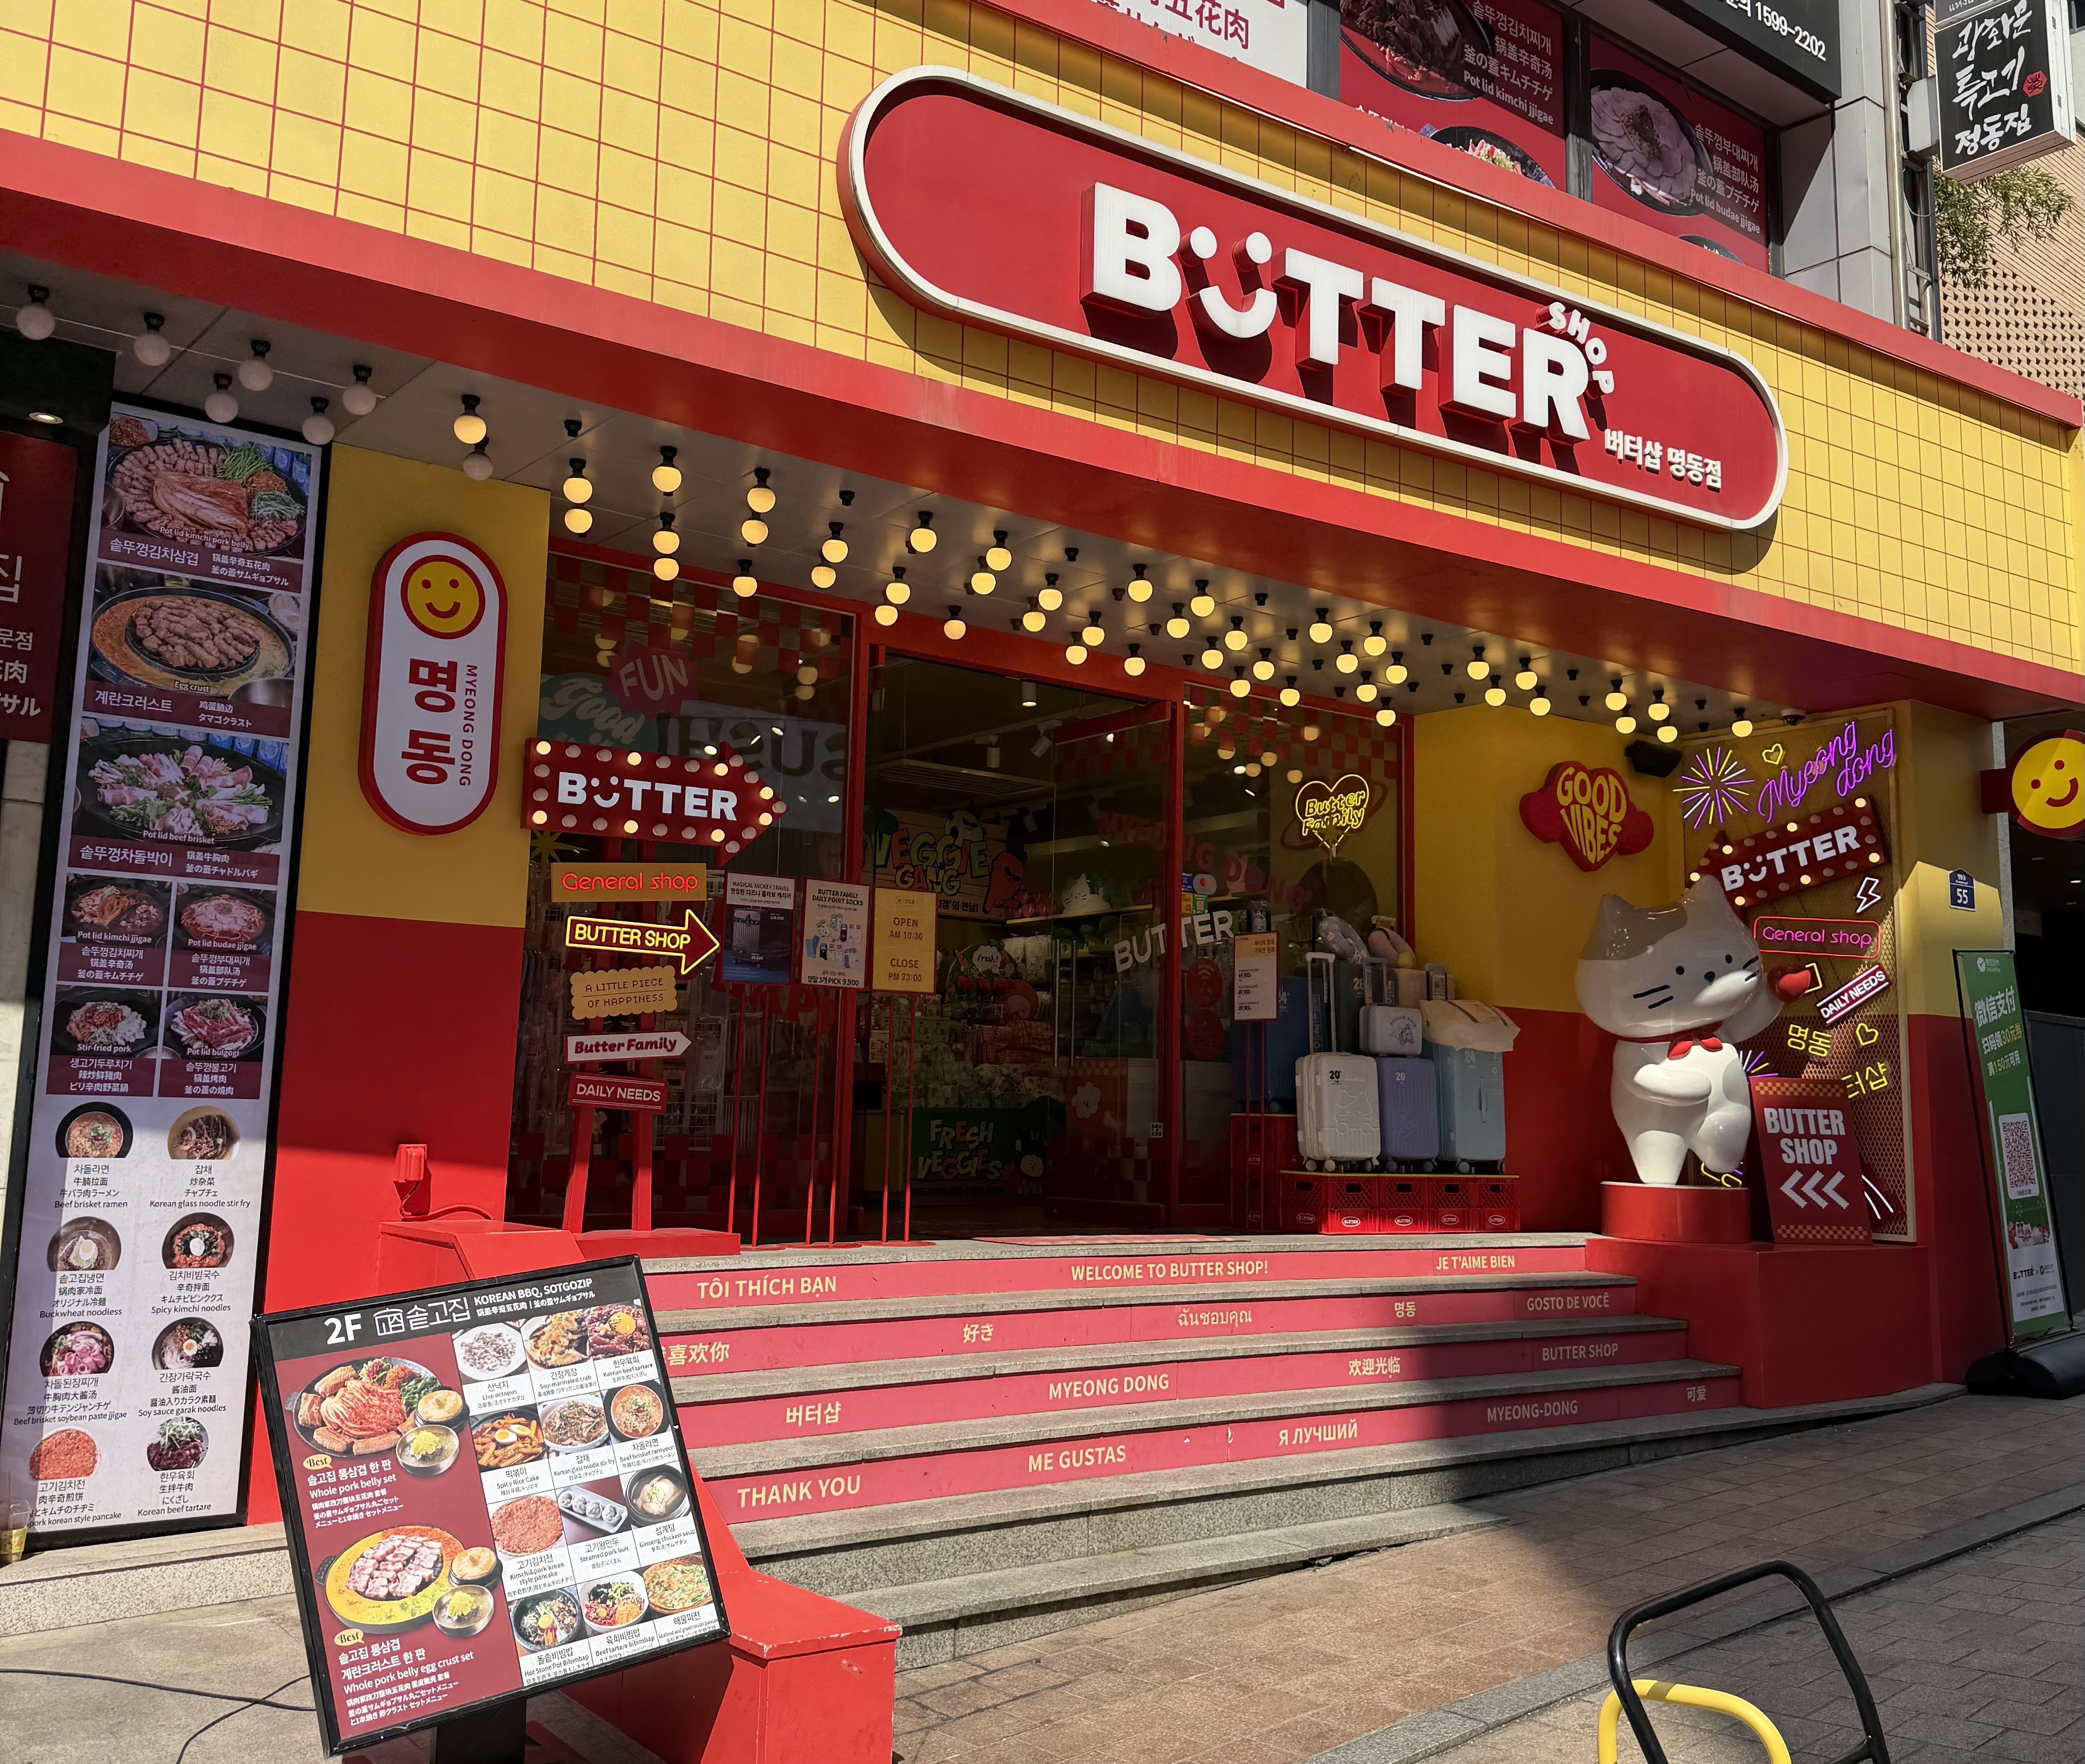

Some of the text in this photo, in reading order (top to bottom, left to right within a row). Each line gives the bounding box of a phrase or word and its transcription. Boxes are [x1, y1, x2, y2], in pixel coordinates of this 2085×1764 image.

[1473, 0, 1551, 55] 솥뚜껑김치찌개
[1755, 1, 1826, 61] 1599-2202
[1495, 35, 1552, 80] 锅盖辛奇汤
[1464, 44, 1553, 101] 釜の蓋キムチチゲ
[1464, 70, 1553, 125] Pot lid kimchi jjigae
[1695, 124, 1758, 172] 솥뚜껑부대찌개
[1713, 155, 1759, 193] 锅盖部队汤
[1691, 188, 1760, 233] Pot lid budae jjigae
[1549, 302, 1615, 394] SHOP
[1604, 428, 1722, 489] 버터샵 명동점
[110, 538, 199, 566] 솥뚜껑김치삼겹
[175, 681, 210, 693] Egg crust
[619, 655, 689, 700] FUN
[95, 690, 173, 712] 계란크러스트
[199, 713, 252, 728] タマゴクラスト
[401, 658, 458, 785] 명동
[459, 664, 477, 787] MYEONG DONG
[1757, 721, 1856, 823] Myeong
[1837, 729, 1895, 797] dong
[1305, 790, 1366, 817] Butter
[1557, 767, 1627, 823] GOOD
[1560, 804, 1622, 864] VIBES
[80, 845, 173, 867] 솥뚜껑차돌박이
[876, 828, 990, 879] VEGGIE
[561, 872, 698, 893] General shop
[895, 864, 961, 896] GANG
[1956, 888, 1968, 904] 55
[893, 917, 919, 927] OPEN
[574, 923, 691, 950] BUTTER SHOP
[903, 931, 923, 940] 10:30
[1762, 926, 1872, 949] General shop
[82, 946, 143, 959] 솥뚜껑김치찌개
[191, 953, 250, 966] 솥뚜껑부대찌개
[891, 958, 919, 968] CLOSE
[596, 981, 629, 992] LITTLE
[632, 978, 664, 988] PIECE
[1820, 970, 1886, 1019] DAILY NEEDS
[587, 994, 664, 1008] OF HAPPINESS
[1975, 985, 2016, 1028] 微信支付
[77, 1044, 132, 1053] Stir-fried pork
[574, 1037, 677, 1055] Butter Family
[1788, 1024, 1832, 1057] 명동
[70, 1058, 132, 1070] 생고기두루치기
[186, 1061, 236, 1073] 솥뚜껑불고기
[576, 1083, 661, 1102] DAILY NEEDS
[1763, 1107, 1846, 1135] BUTTER
[929, 1119, 994, 1149] FRESH
[917, 1148, 1002, 1180] VEGGIES
[1780, 1138, 1838, 1165] SHOP
[74, 1164, 109, 1174] 차돌라면
[195, 1165, 212, 1174] 잡채
[240, 1200, 250, 1208] fry
[1071, 1260, 1268, 1281] WELCOME TO BUTTER SHOP!
[1435, 1254, 1516, 1271] JE T'AIME BIEN
[59, 1273, 104, 1284] 솥고집냉면
[169, 1271, 220, 1281] 김치비빔국수
[696, 1274, 837, 1300] TÔI THÍCH BẠN
[473, 1278, 593, 1306] KOREAN BBQ, SOTGOZIP
[1526, 1292, 1610, 1312] GOSTO DE VOCÊ
[1177, 1307, 1253, 1328] ฉันชอบคุณ
[1394, 1301, 1417, 1319] 명동
[323, 1314, 363, 1345] 2F
[963, 1323, 995, 1344] 好き
[662, 1340, 729, 1366] 喜欢你
[1542, 1342, 1619, 1361] BUTTER SHOP
[550, 1368, 578, 1379] 간장게장
[1348, 1355, 1401, 1377] 欢迎光临
[44, 1377, 98, 1387] 차돌된장찌개
[487, 1380, 509, 1391] 산낙지
[1049, 1373, 1169, 1400] MYEONG DONG
[1686, 1384, 1707, 1402] 可爱
[785, 1401, 842, 1427] 버터샵
[1487, 1399, 1579, 1423] MYEONG-DONG
[1279, 1418, 1358, 1446] Я ЛУЧШИЙ
[306, 1457, 329, 1468] Best
[1028, 1444, 1127, 1473] ME GUSTAS
[307, 1471, 336, 1486] 솥고집
[369, 1462, 380, 1474] 한
[381, 1459, 392, 1471] 판
[505, 1467, 527, 1477] 떡볶이
[39, 1480, 85, 1492] 고기김치전
[737, 1474, 861, 1509] THANK YOU
[343, 1651, 474, 1695] Whole pork belly egg crust set
